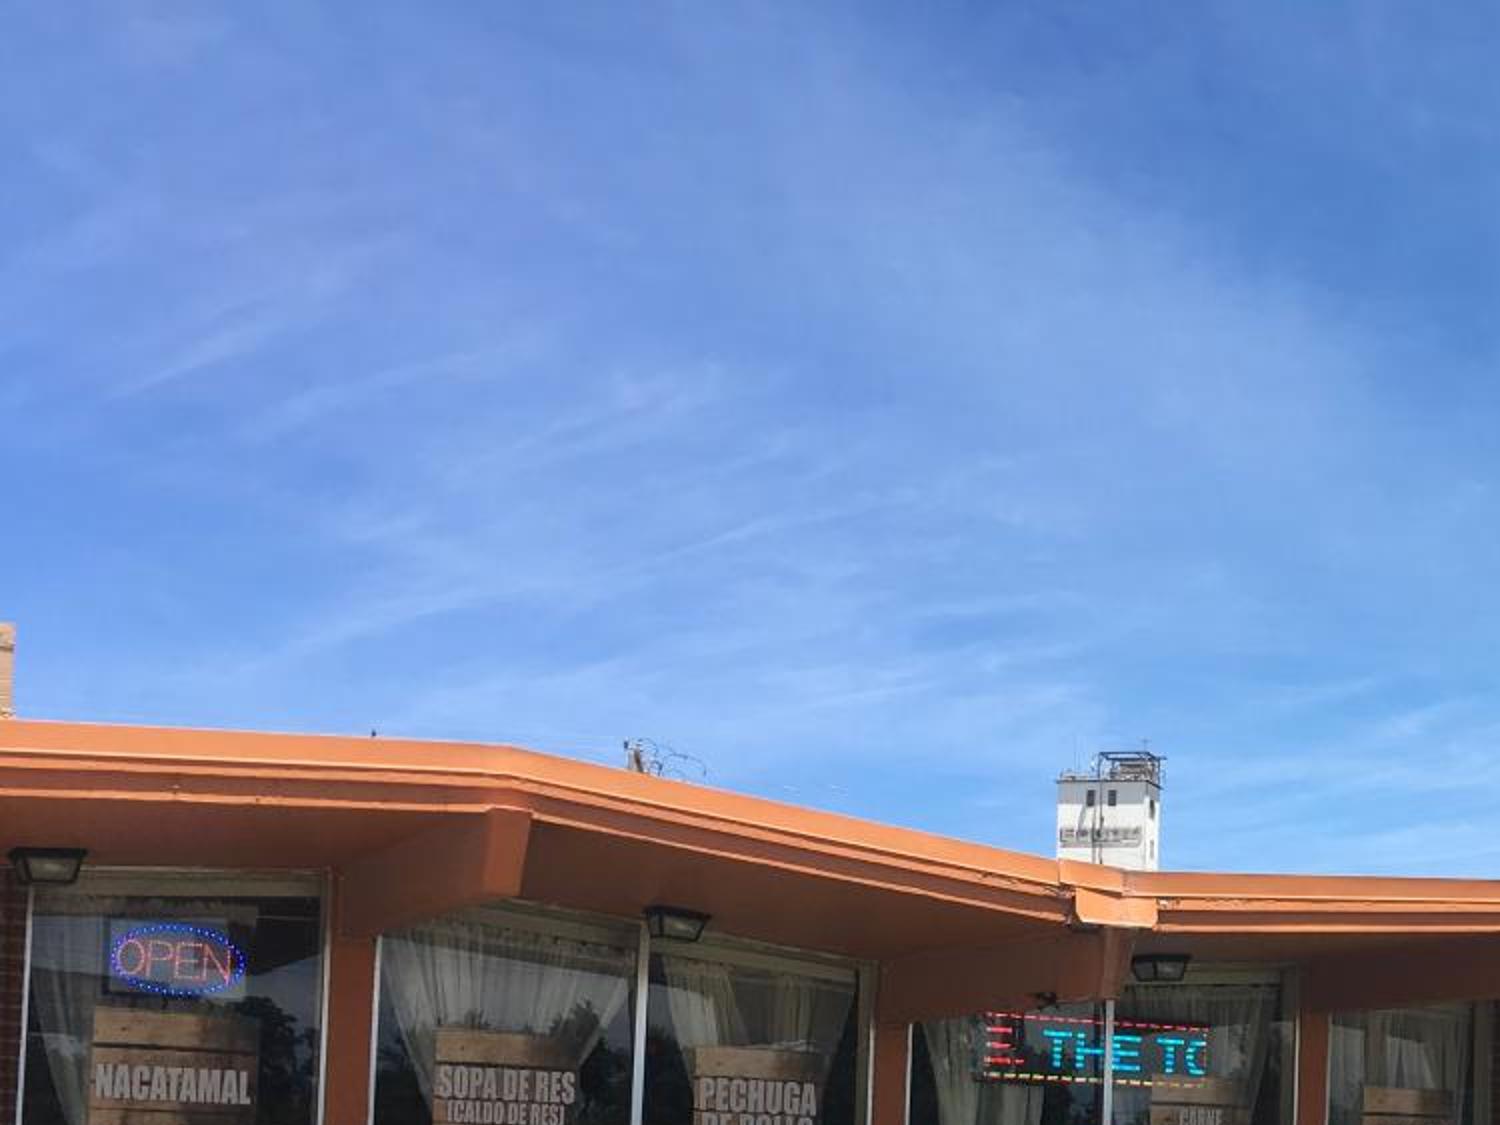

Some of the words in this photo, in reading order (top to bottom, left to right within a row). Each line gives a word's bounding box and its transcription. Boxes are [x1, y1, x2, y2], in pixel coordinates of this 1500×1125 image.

[117, 939, 232, 985] OPEN
[1043, 1028, 1142, 1071] THE
[95, 1063, 251, 1105] NACATAMAL
[438, 1065, 498, 1100] SOPA
[503, 1068, 530, 1102] DE
[535, 1071, 576, 1105] RES
[702, 1077, 817, 1117] PECHUGA
[508, 1102, 528, 1125] DE
